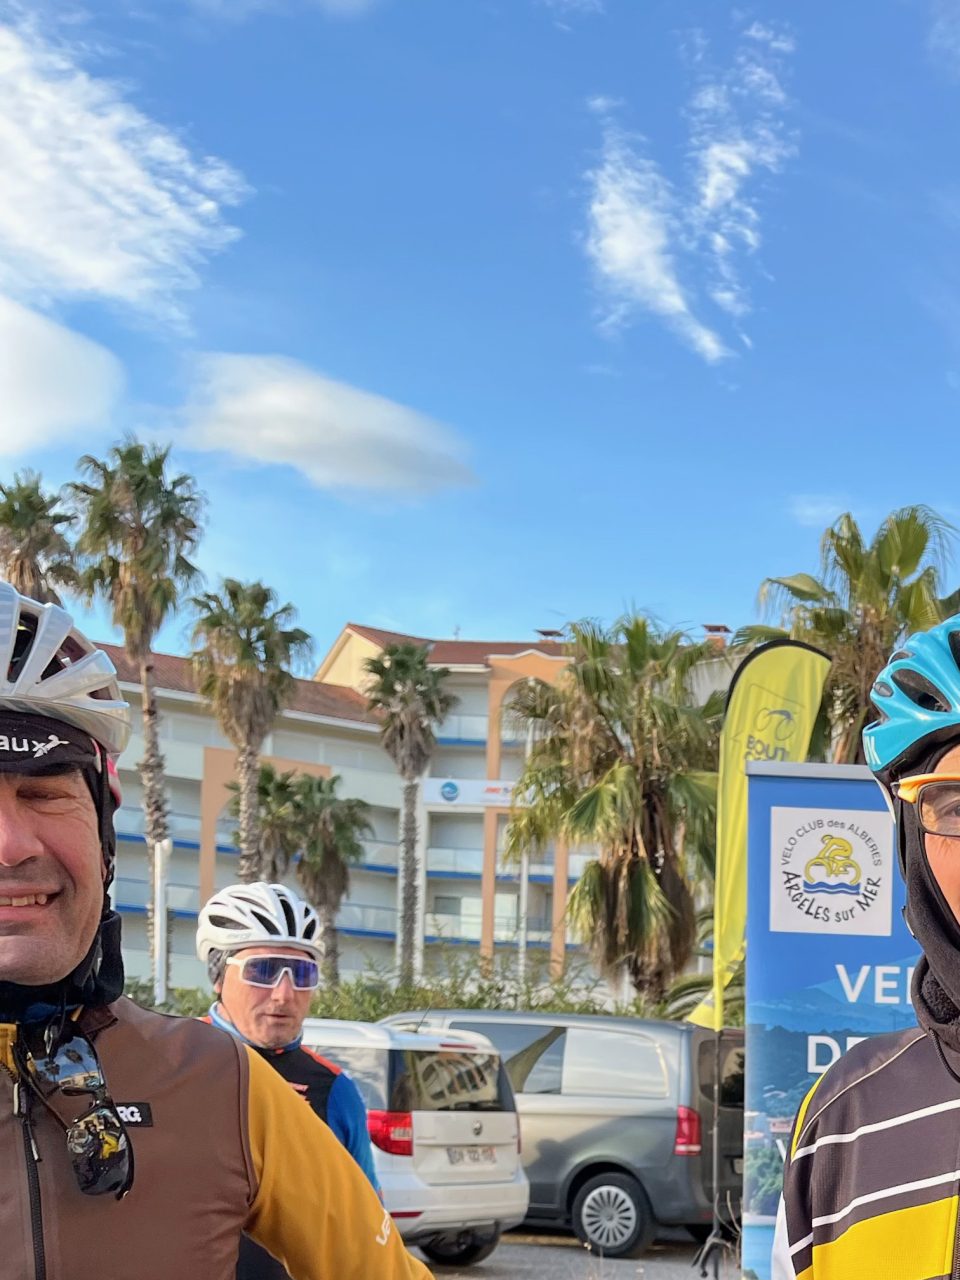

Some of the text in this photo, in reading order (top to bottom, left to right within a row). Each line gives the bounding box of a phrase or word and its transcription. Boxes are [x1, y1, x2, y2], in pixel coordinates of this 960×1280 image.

[781, 836, 797, 866] VELO
[795, 819, 824, 838] CLUB
[826, 819, 846, 829] des
[855, 877, 882, 912] MER
